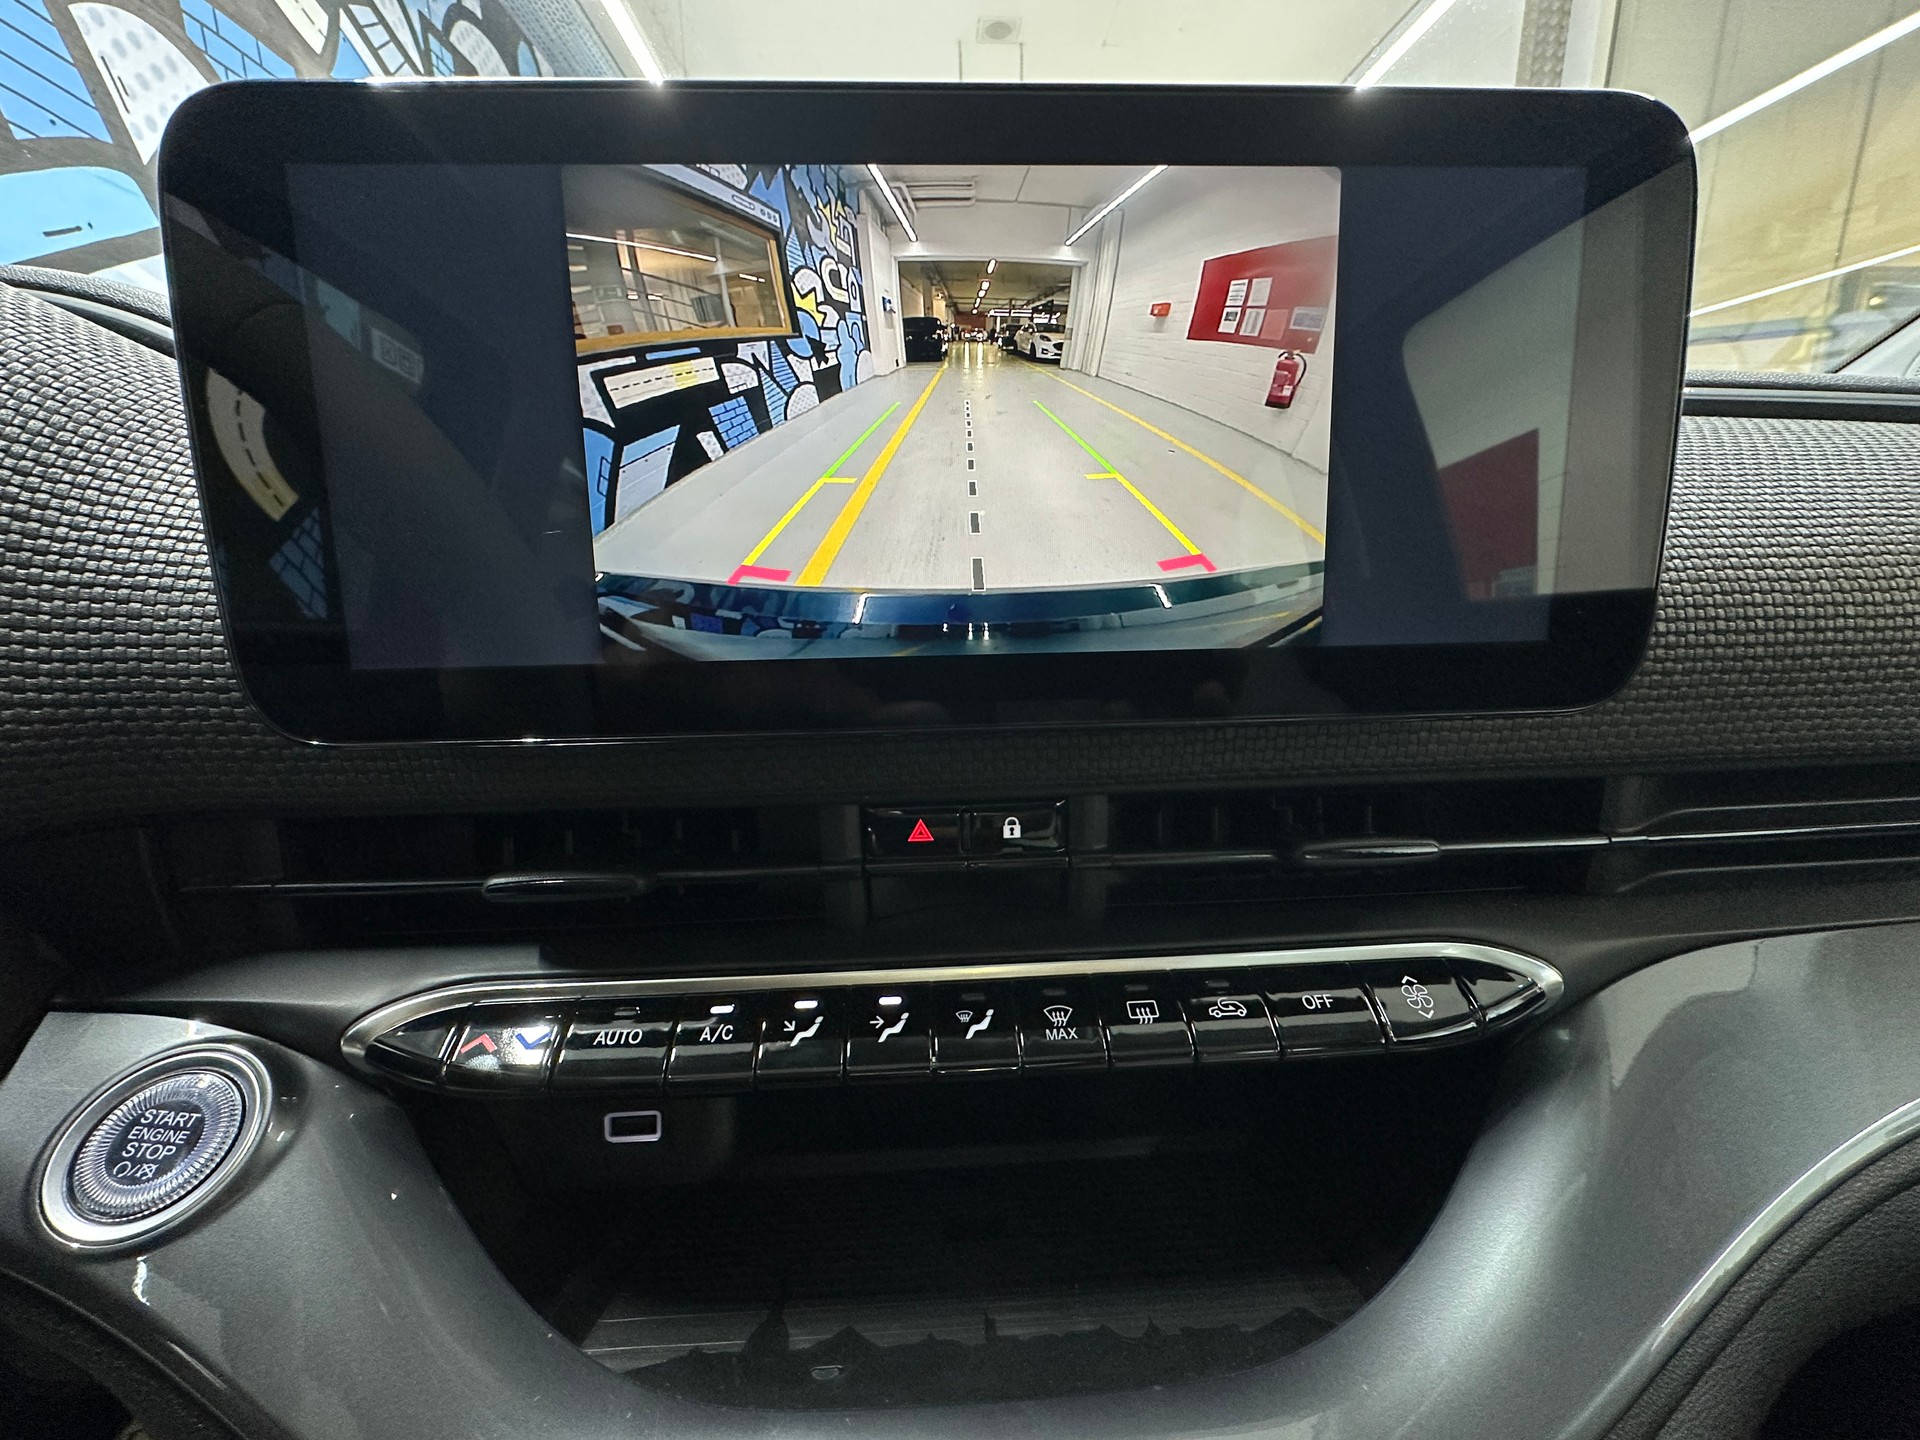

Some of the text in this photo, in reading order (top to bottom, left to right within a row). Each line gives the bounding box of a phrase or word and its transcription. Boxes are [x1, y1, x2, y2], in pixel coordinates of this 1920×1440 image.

[1301, 993, 1334, 1010] OFF
[593, 1028, 643, 1045] AUTO
[699, 1024, 734, 1042] A/C
[1045, 1027, 1079, 1041] MAX
[140, 1108, 202, 1128] START
[127, 1125, 191, 1144] ENGINE
[121, 1141, 177, 1160] STOP
